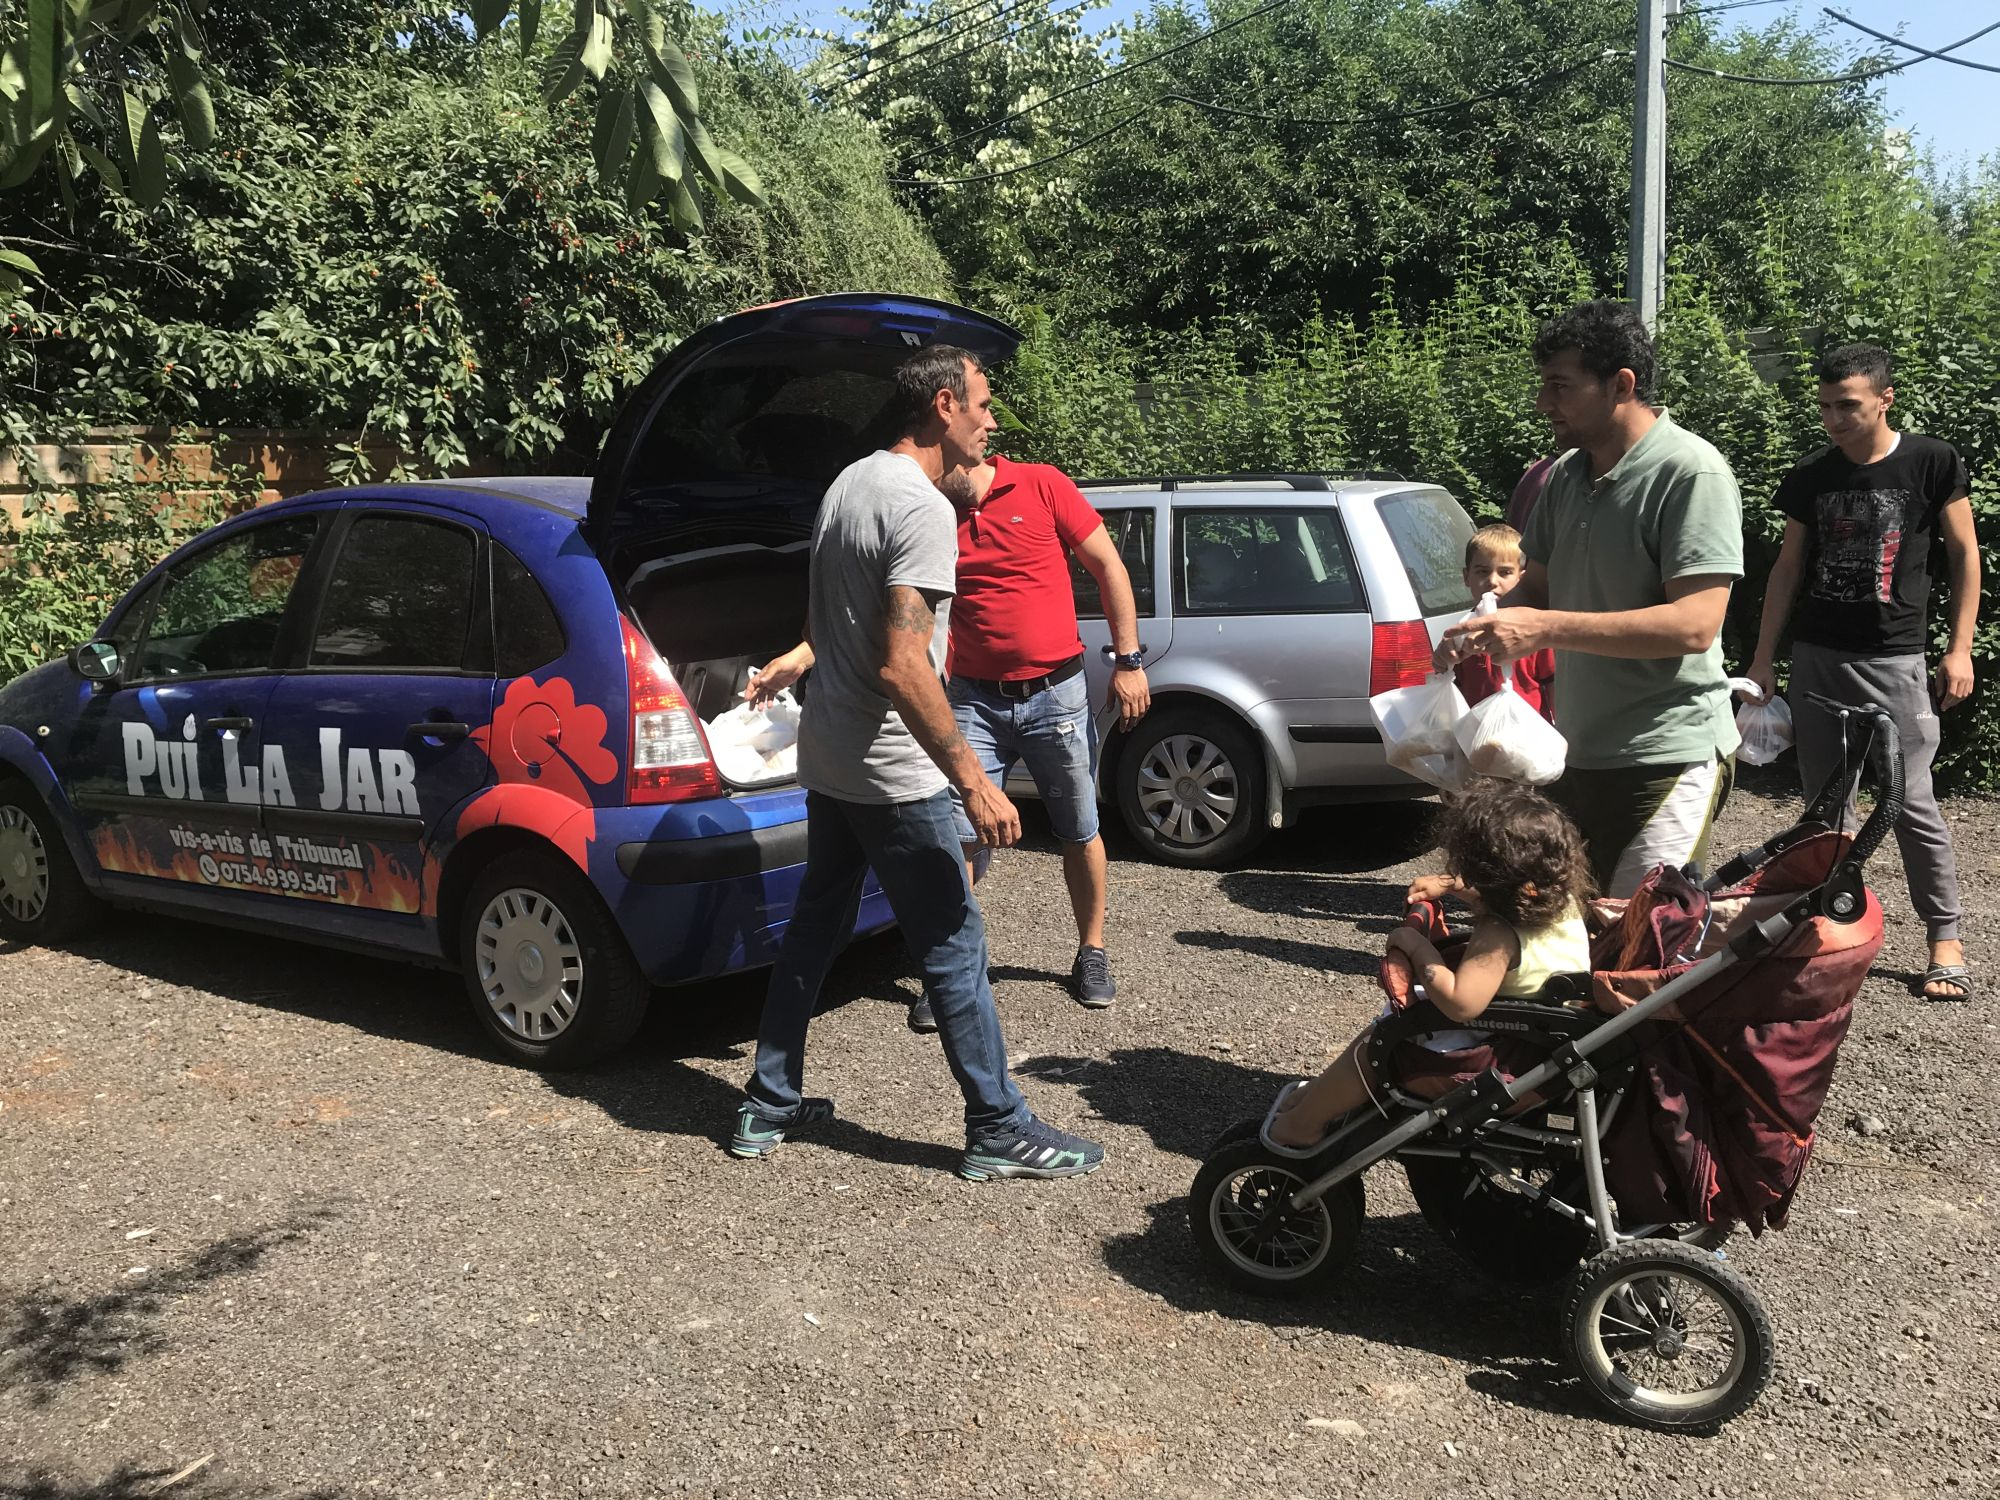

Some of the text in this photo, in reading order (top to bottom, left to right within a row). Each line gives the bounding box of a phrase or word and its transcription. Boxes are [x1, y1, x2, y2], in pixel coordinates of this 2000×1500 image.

[169, 825, 364, 869] vis-a-vis de Tribunal
[220, 862, 337, 895] 0754.939.547
